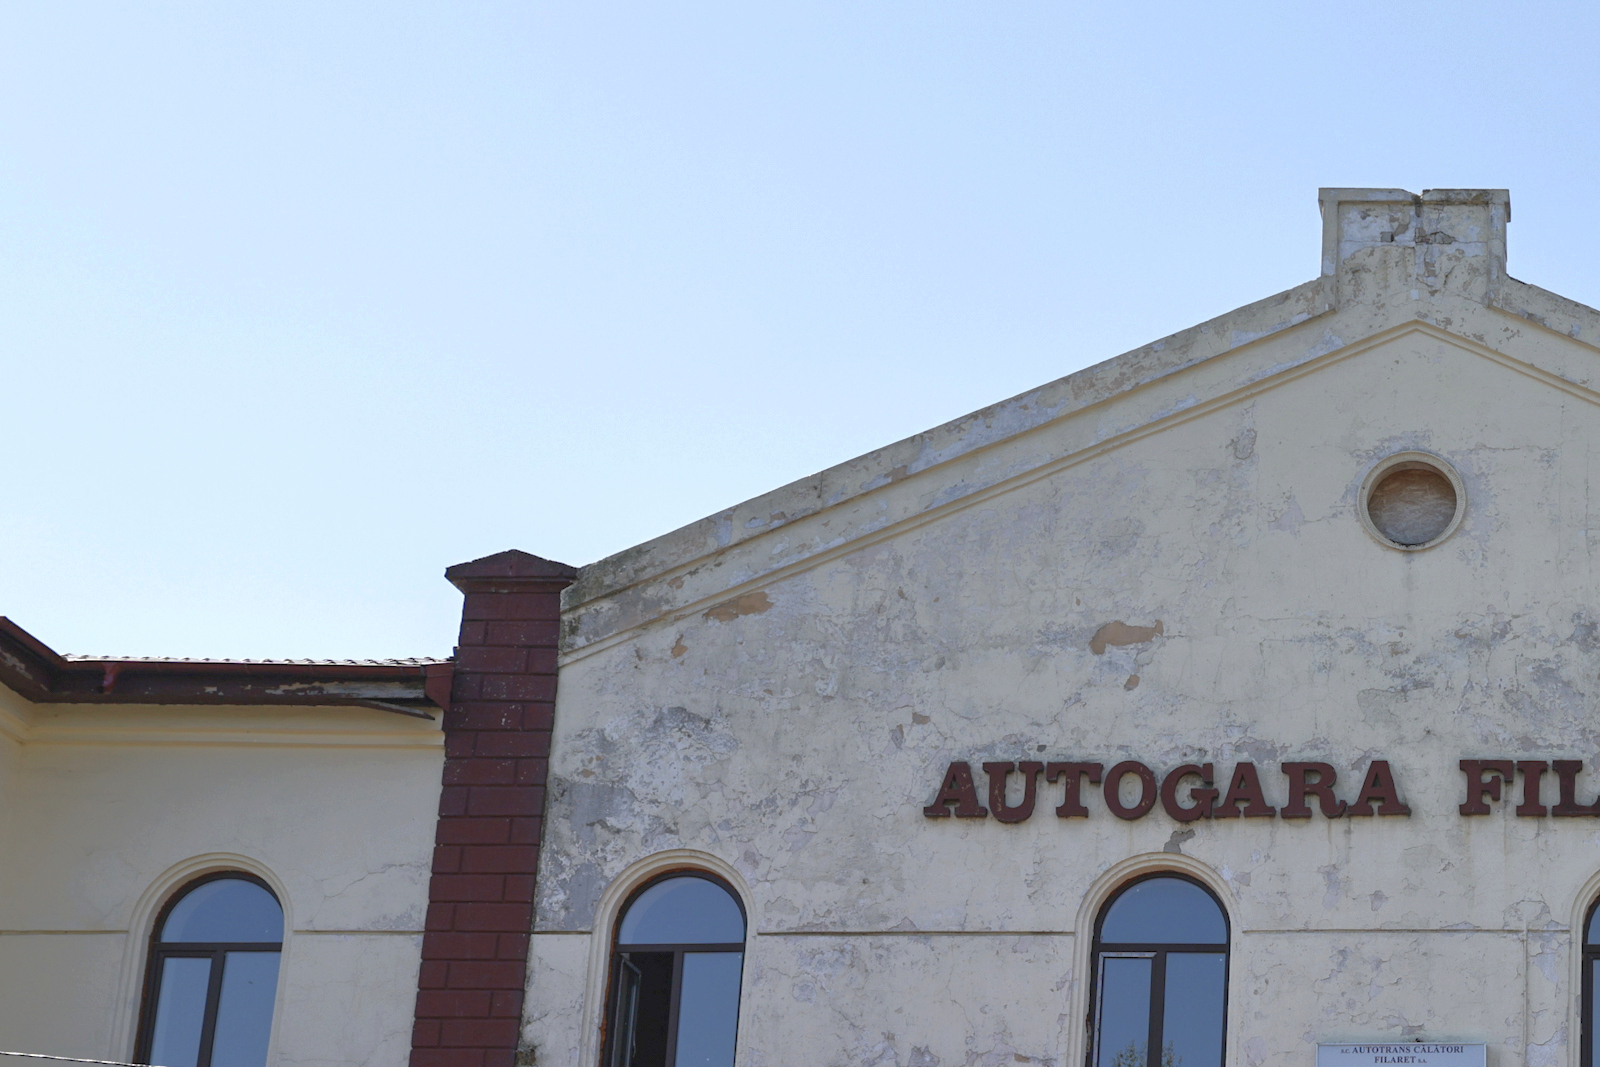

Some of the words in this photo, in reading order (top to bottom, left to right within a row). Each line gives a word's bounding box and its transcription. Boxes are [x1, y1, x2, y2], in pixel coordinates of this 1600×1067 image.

[923, 759, 1411, 822] AUTOGARA
[1352, 1046, 1411, 1054] AUTOTRANS
[1374, 1056, 1416, 1064] FILARET
